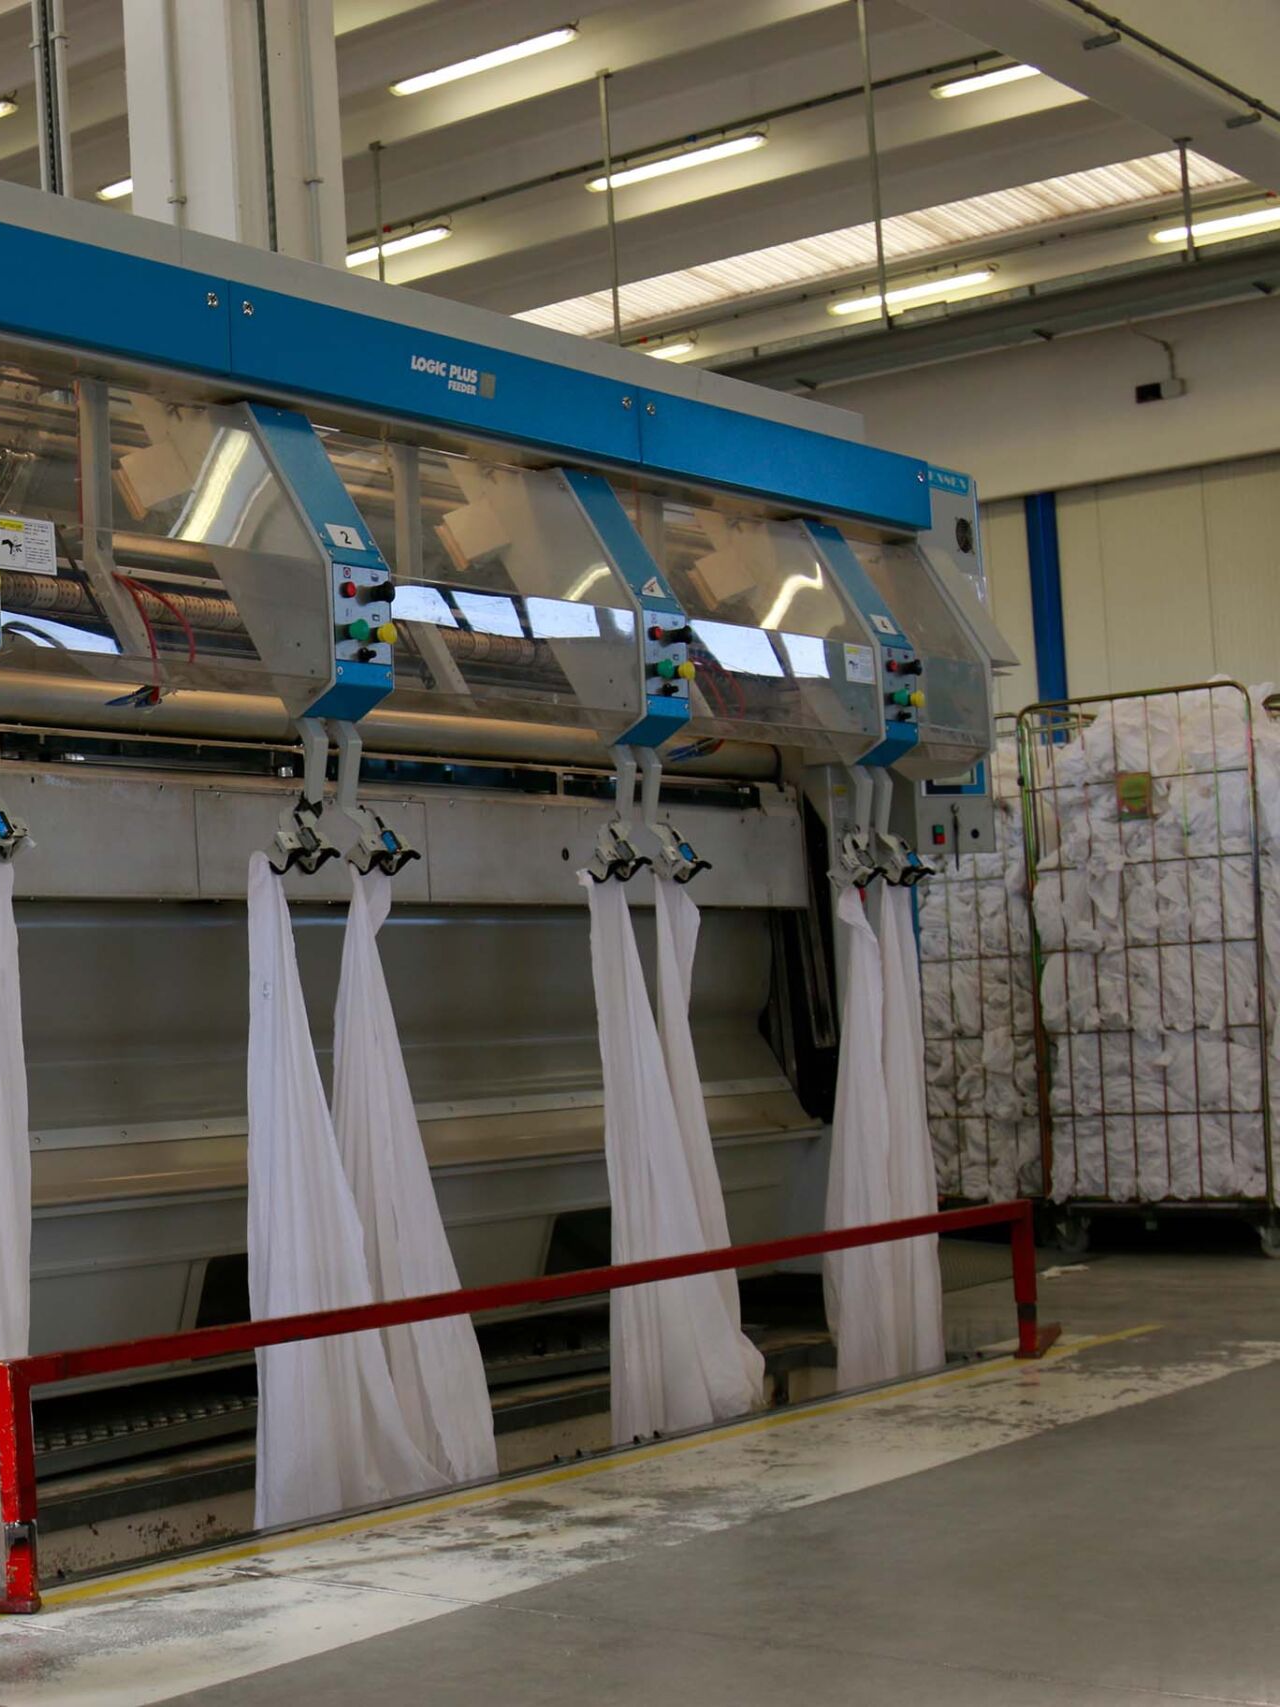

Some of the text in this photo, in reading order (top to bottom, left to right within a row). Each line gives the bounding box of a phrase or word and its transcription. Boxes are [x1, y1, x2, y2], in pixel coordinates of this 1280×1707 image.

[411, 355, 478, 384] LOGIC PLUS
[448, 379, 477, 396] FEEDER
[340, 530, 352, 545] 2
